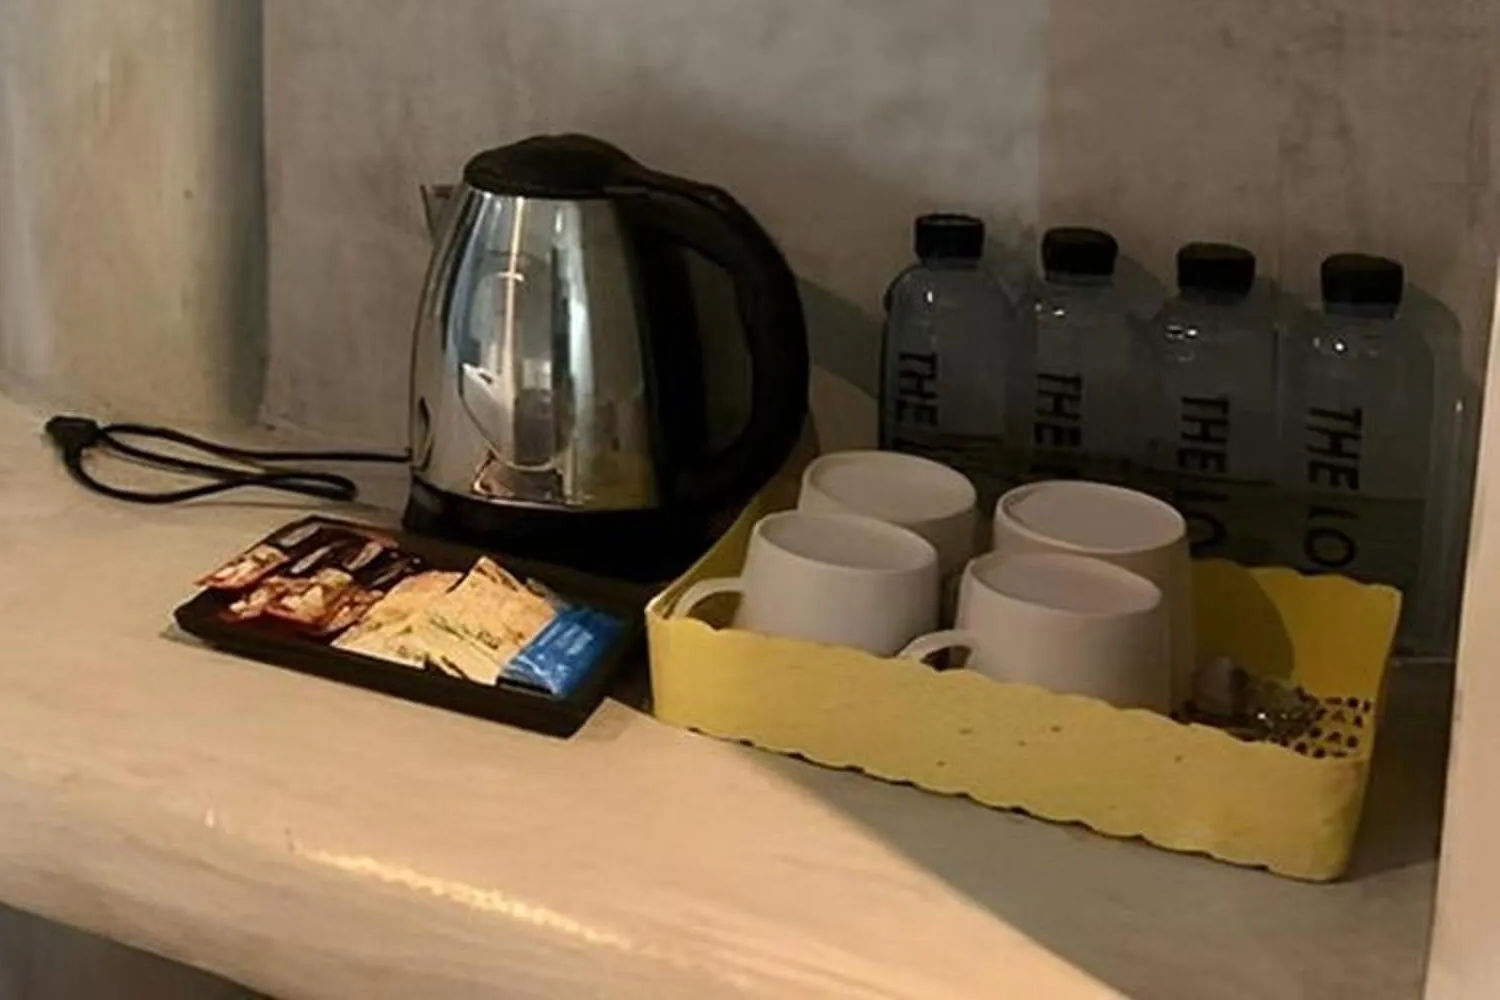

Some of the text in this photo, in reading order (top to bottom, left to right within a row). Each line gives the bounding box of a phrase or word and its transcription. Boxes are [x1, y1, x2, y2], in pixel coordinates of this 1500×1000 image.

[897, 352, 938, 426] THE
[1034, 373, 1082, 446] THE
[1177, 396, 1230, 473] THE
[1306, 407, 1363, 490] THE
